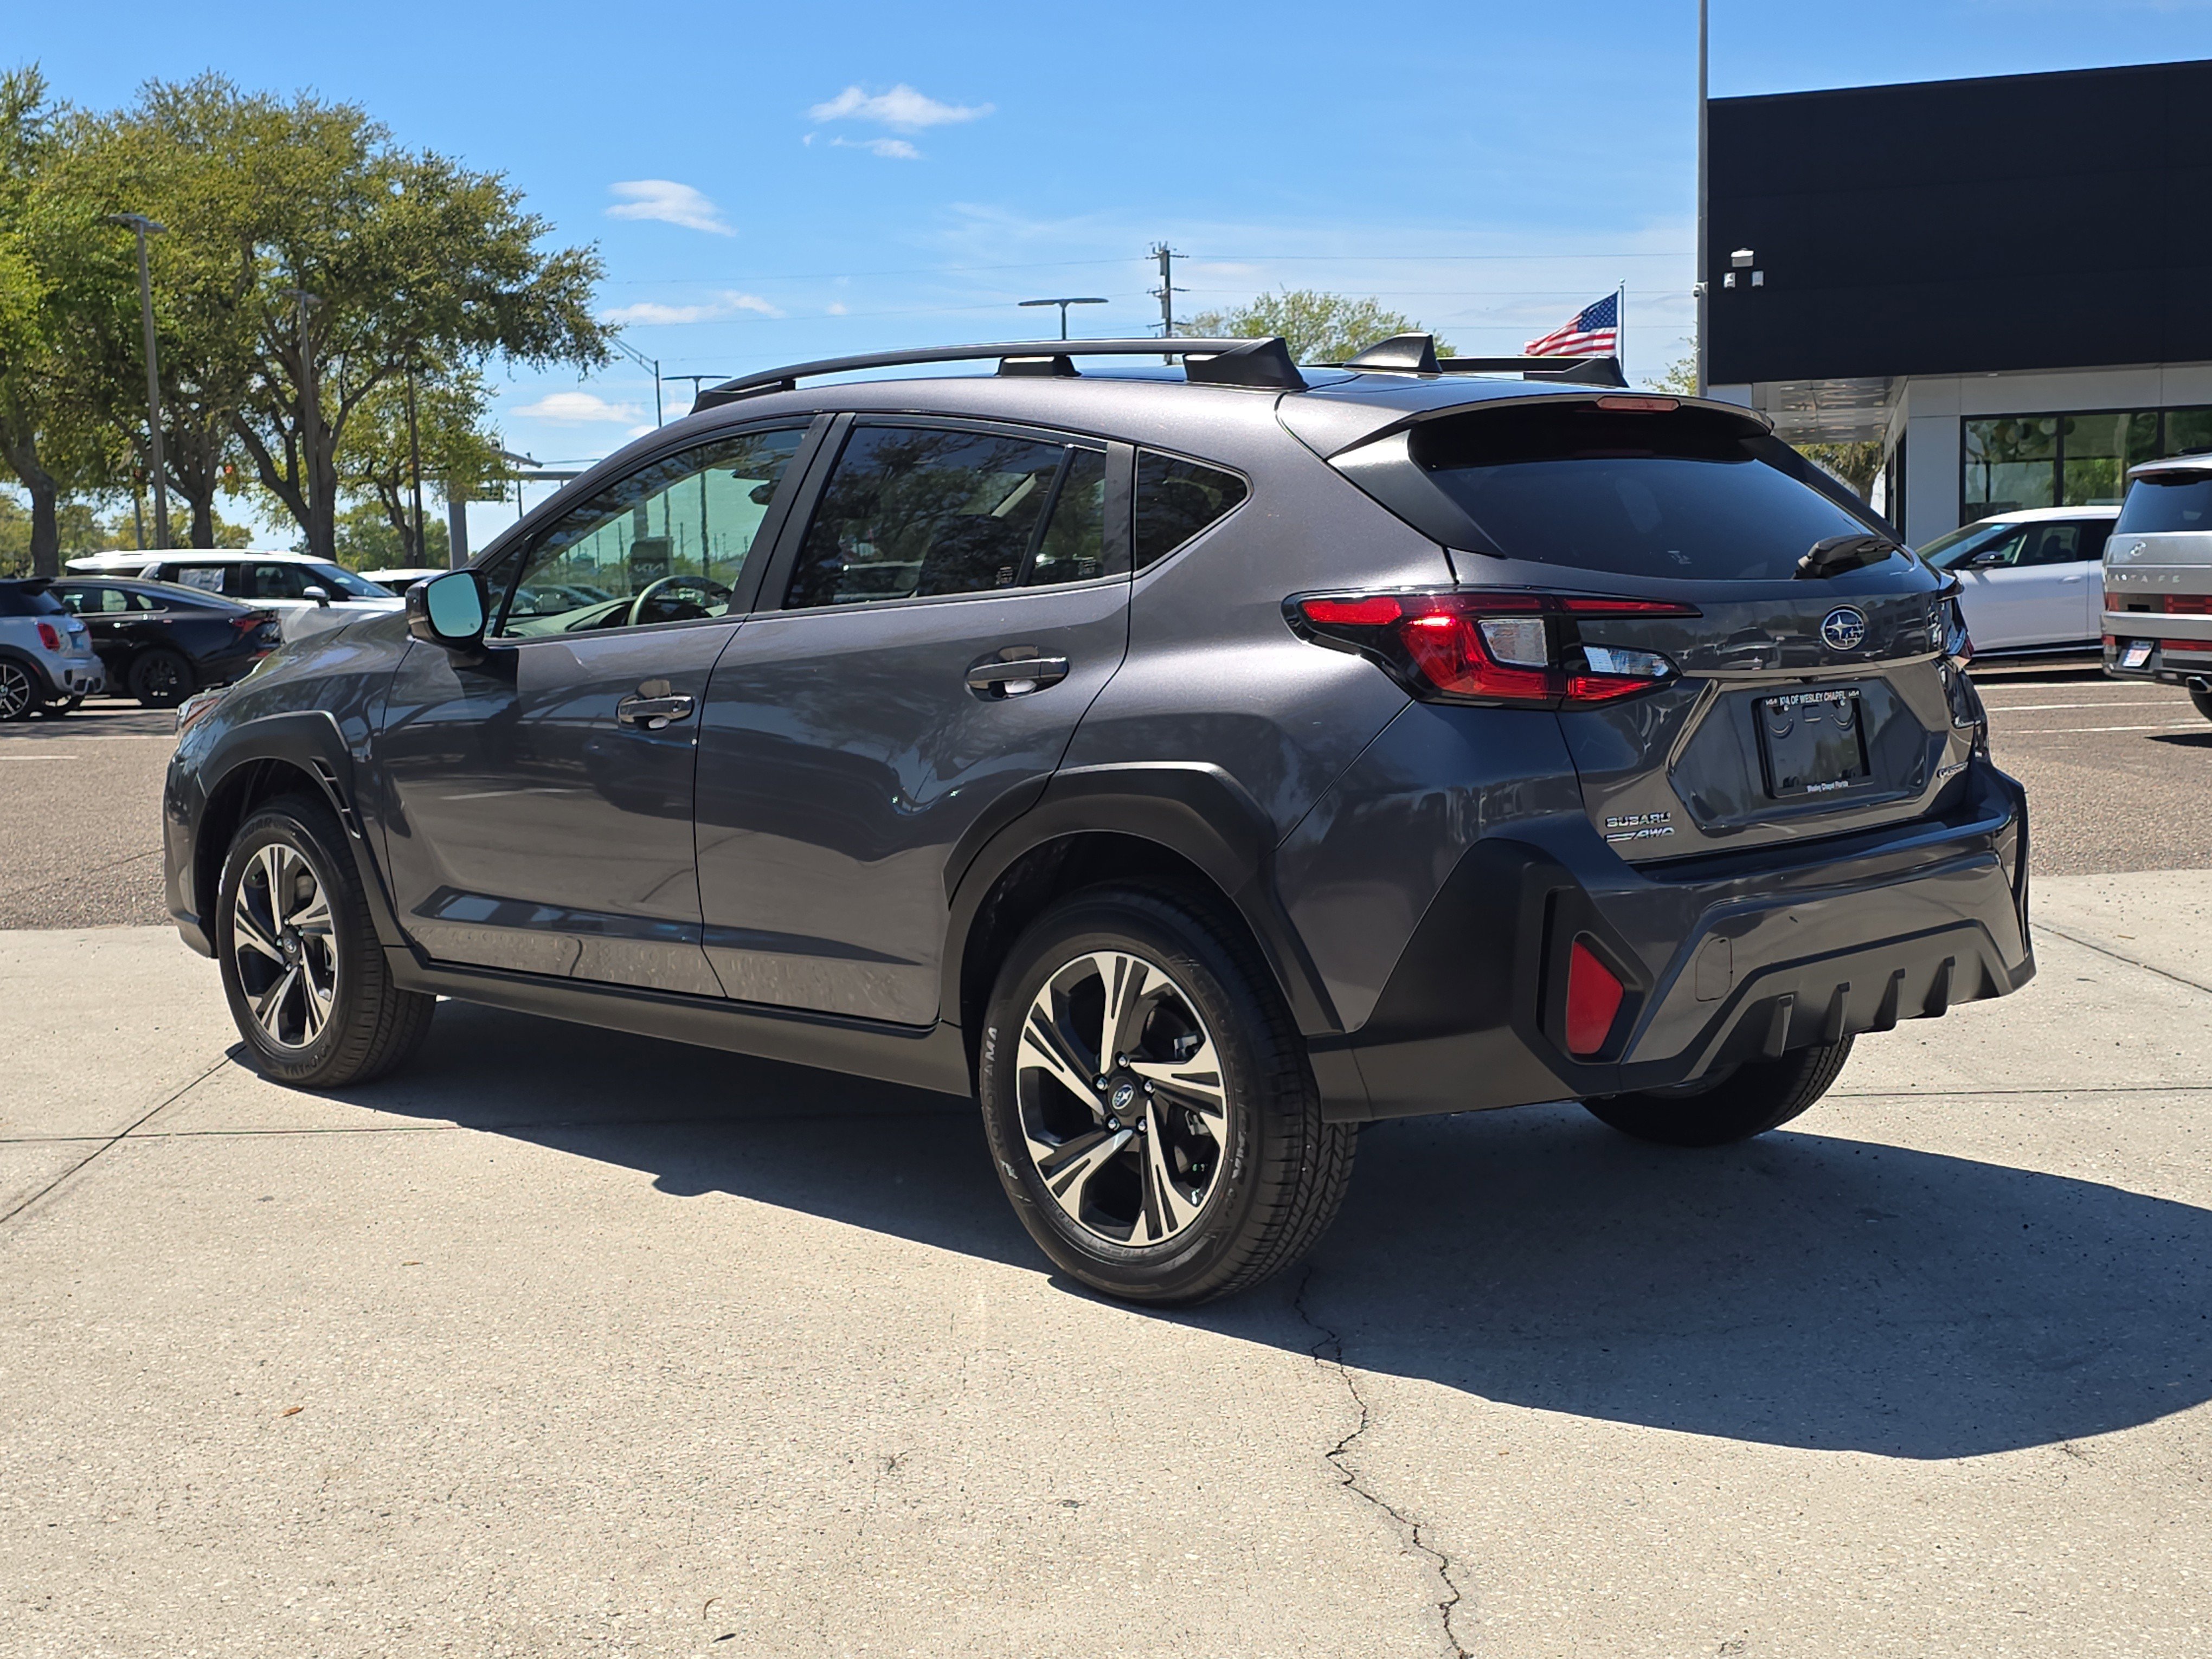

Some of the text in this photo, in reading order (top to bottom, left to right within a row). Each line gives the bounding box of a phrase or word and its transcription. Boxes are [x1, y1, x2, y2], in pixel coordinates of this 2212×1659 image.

[1791, 695, 1799, 705] OF
[1800, 692, 1823, 704] WESLEY
[1824, 690, 1847, 702] CHAPEL
[1605, 812, 1671, 828] SUBARU
